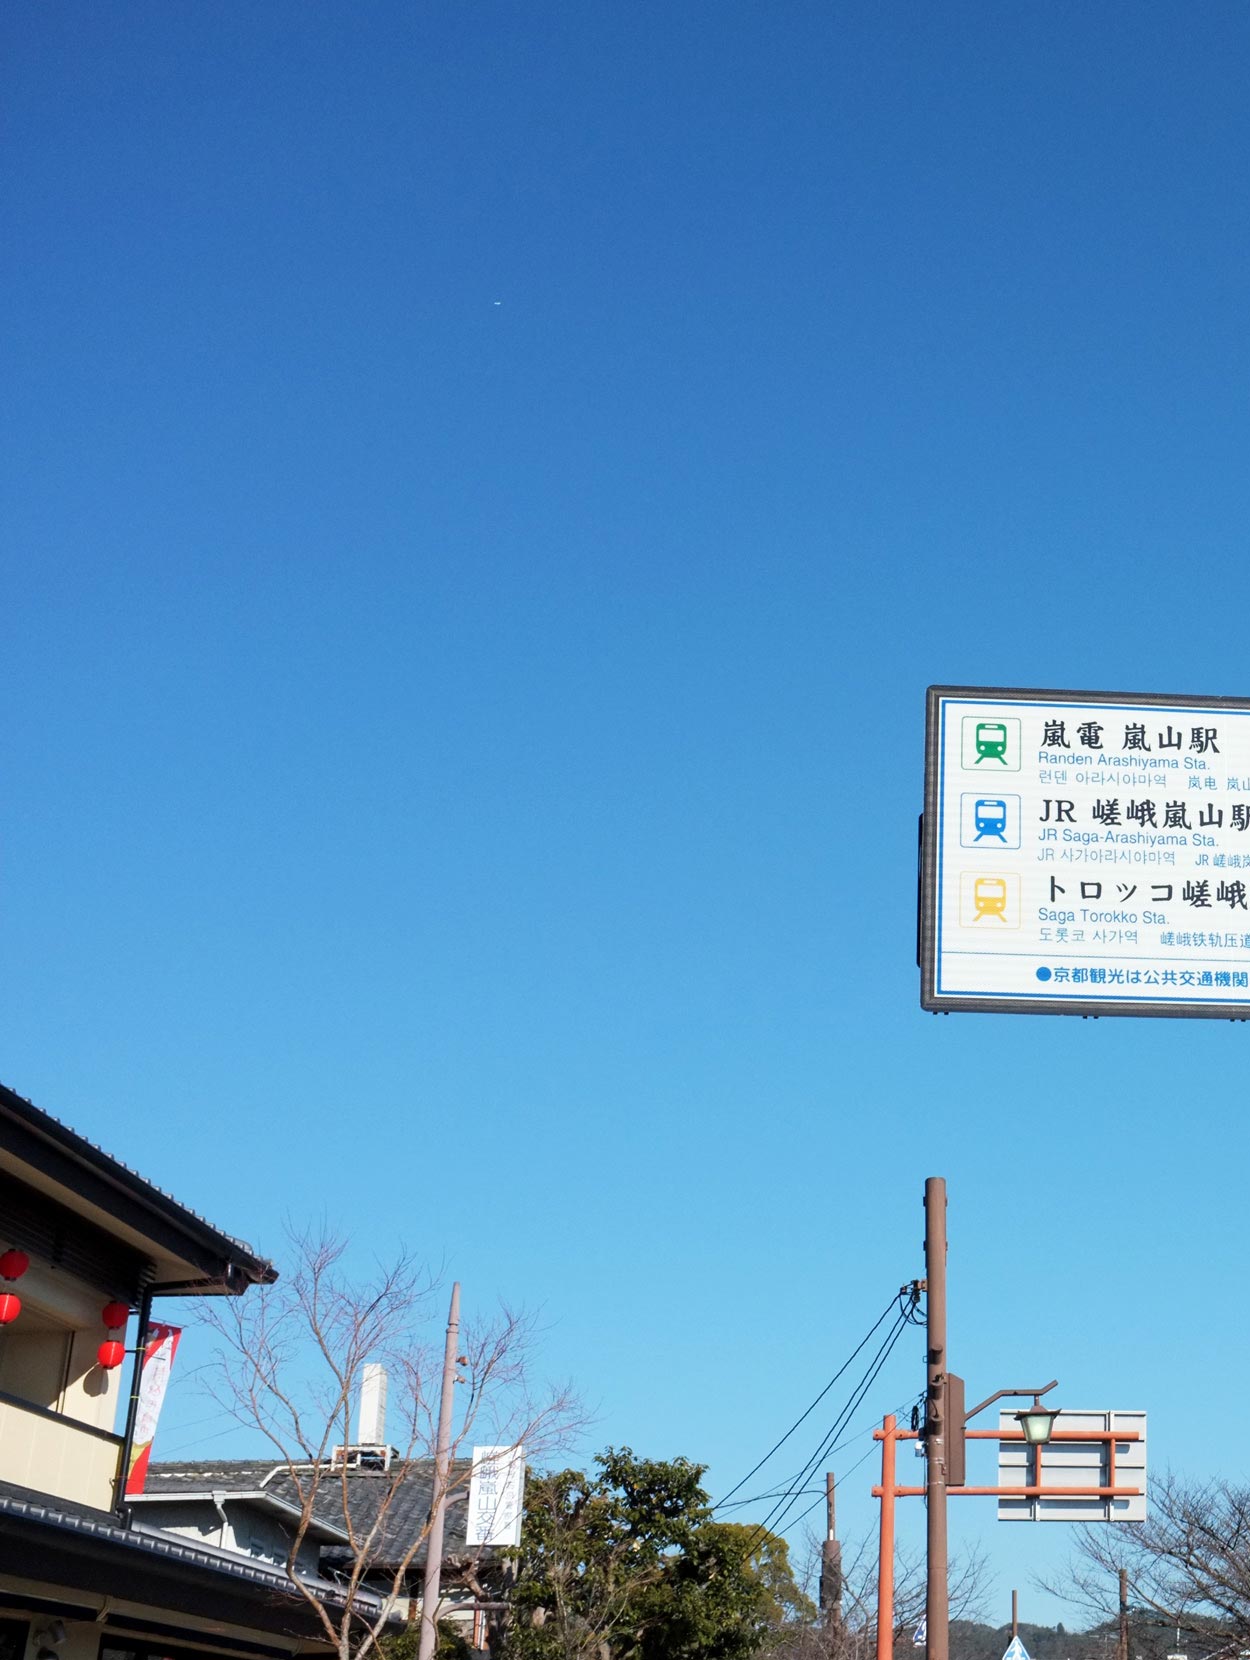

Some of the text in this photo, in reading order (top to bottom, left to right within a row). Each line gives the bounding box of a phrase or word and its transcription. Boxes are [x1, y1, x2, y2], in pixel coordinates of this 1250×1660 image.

[1041, 719, 1220, 754] 嵐電 嵐山駅
[1039, 751, 1210, 770] Randen Arashiyama Sta.
[1076, 771, 1166, 787] 아라시야마역
[1188, 776, 1217, 790] 岚电
[1039, 799, 1077, 823] JR
[1038, 828, 1219, 847] JR Saga-Arashiyama Sta.
[1038, 848, 1174, 865] JR 사가아라시야마역
[1195, 854, 1209, 866] JR
[1039, 908, 1169, 925] Saga Torokko Sta.
[1040, 928, 1137, 944] 도롯코 사가역
